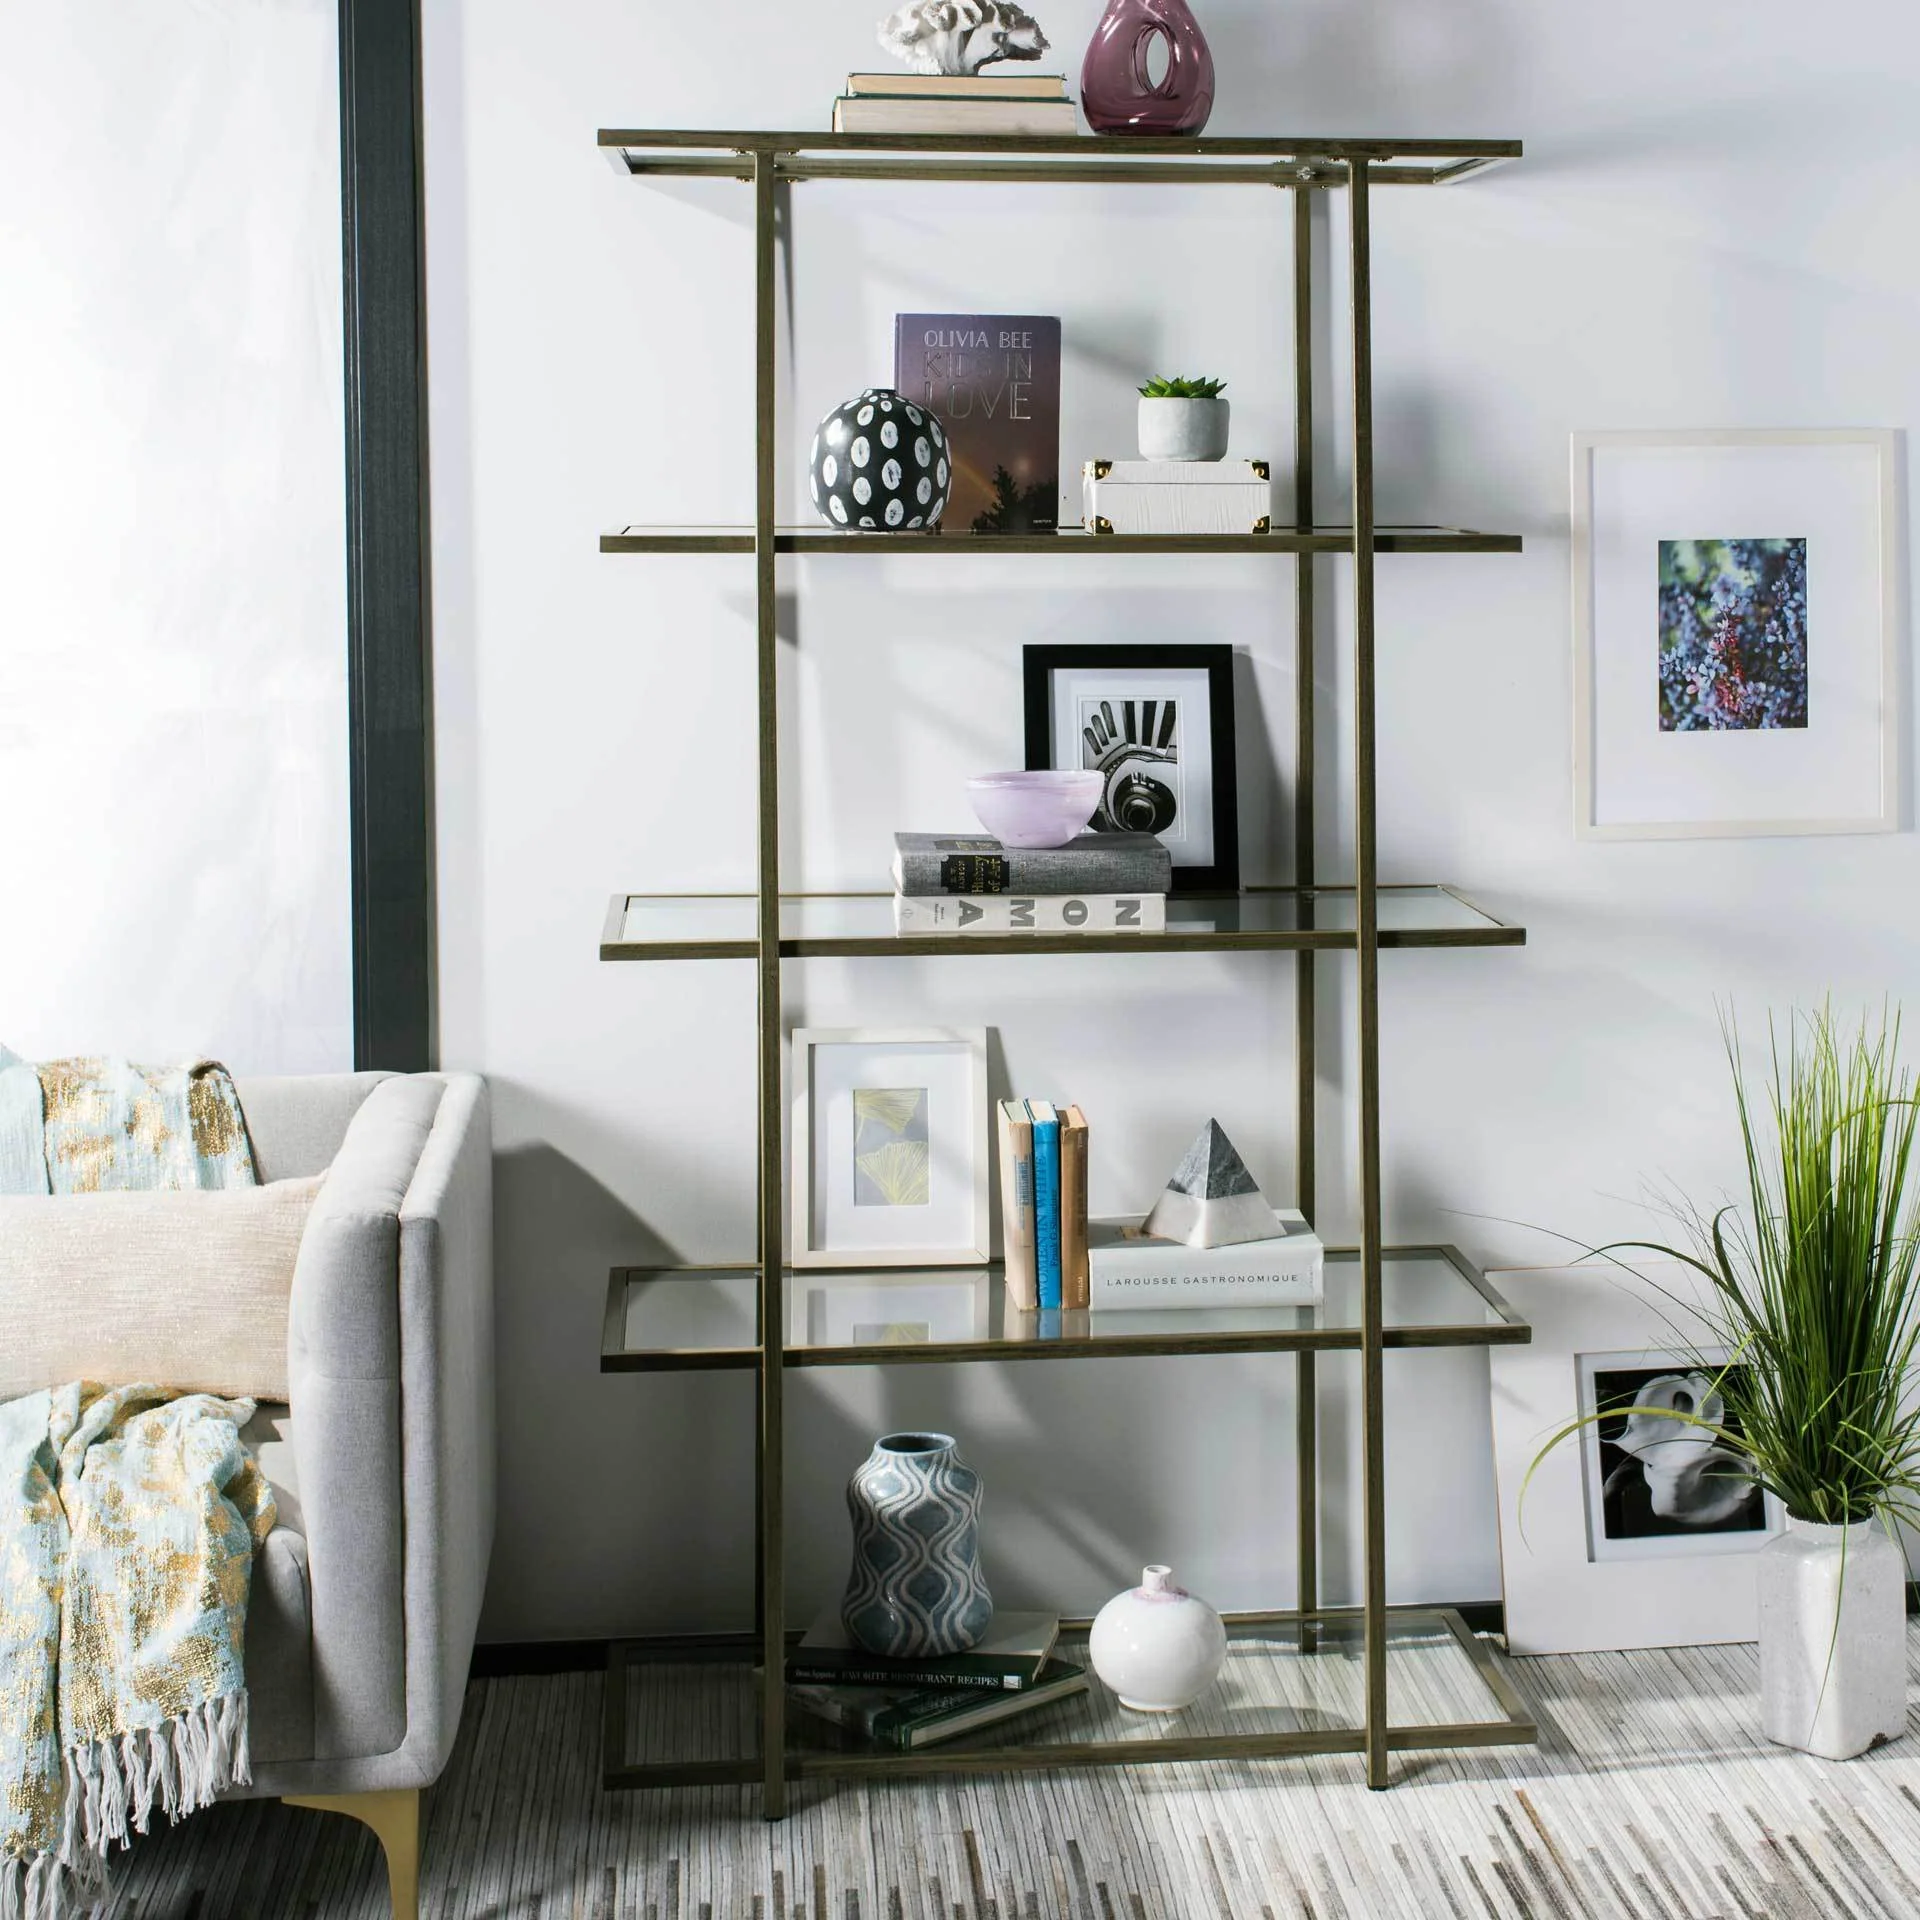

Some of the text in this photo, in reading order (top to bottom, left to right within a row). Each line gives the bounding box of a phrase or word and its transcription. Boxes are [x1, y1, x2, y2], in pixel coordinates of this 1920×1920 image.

[923, 329, 1034, 349] OLIVIA BEE
[1005, 352, 1033, 380] IN
[924, 381, 1033, 421] LOVE
[987, 880, 1001, 892] of
[1035, 1155, 1050, 1296] WOMEN IN WHITE
[1106, 1277, 1178, 1287] LAROUSSE
[1183, 1274, 1299, 1285] GASTRONOMIQUE
[956, 1675, 1000, 1687] RECIPES
